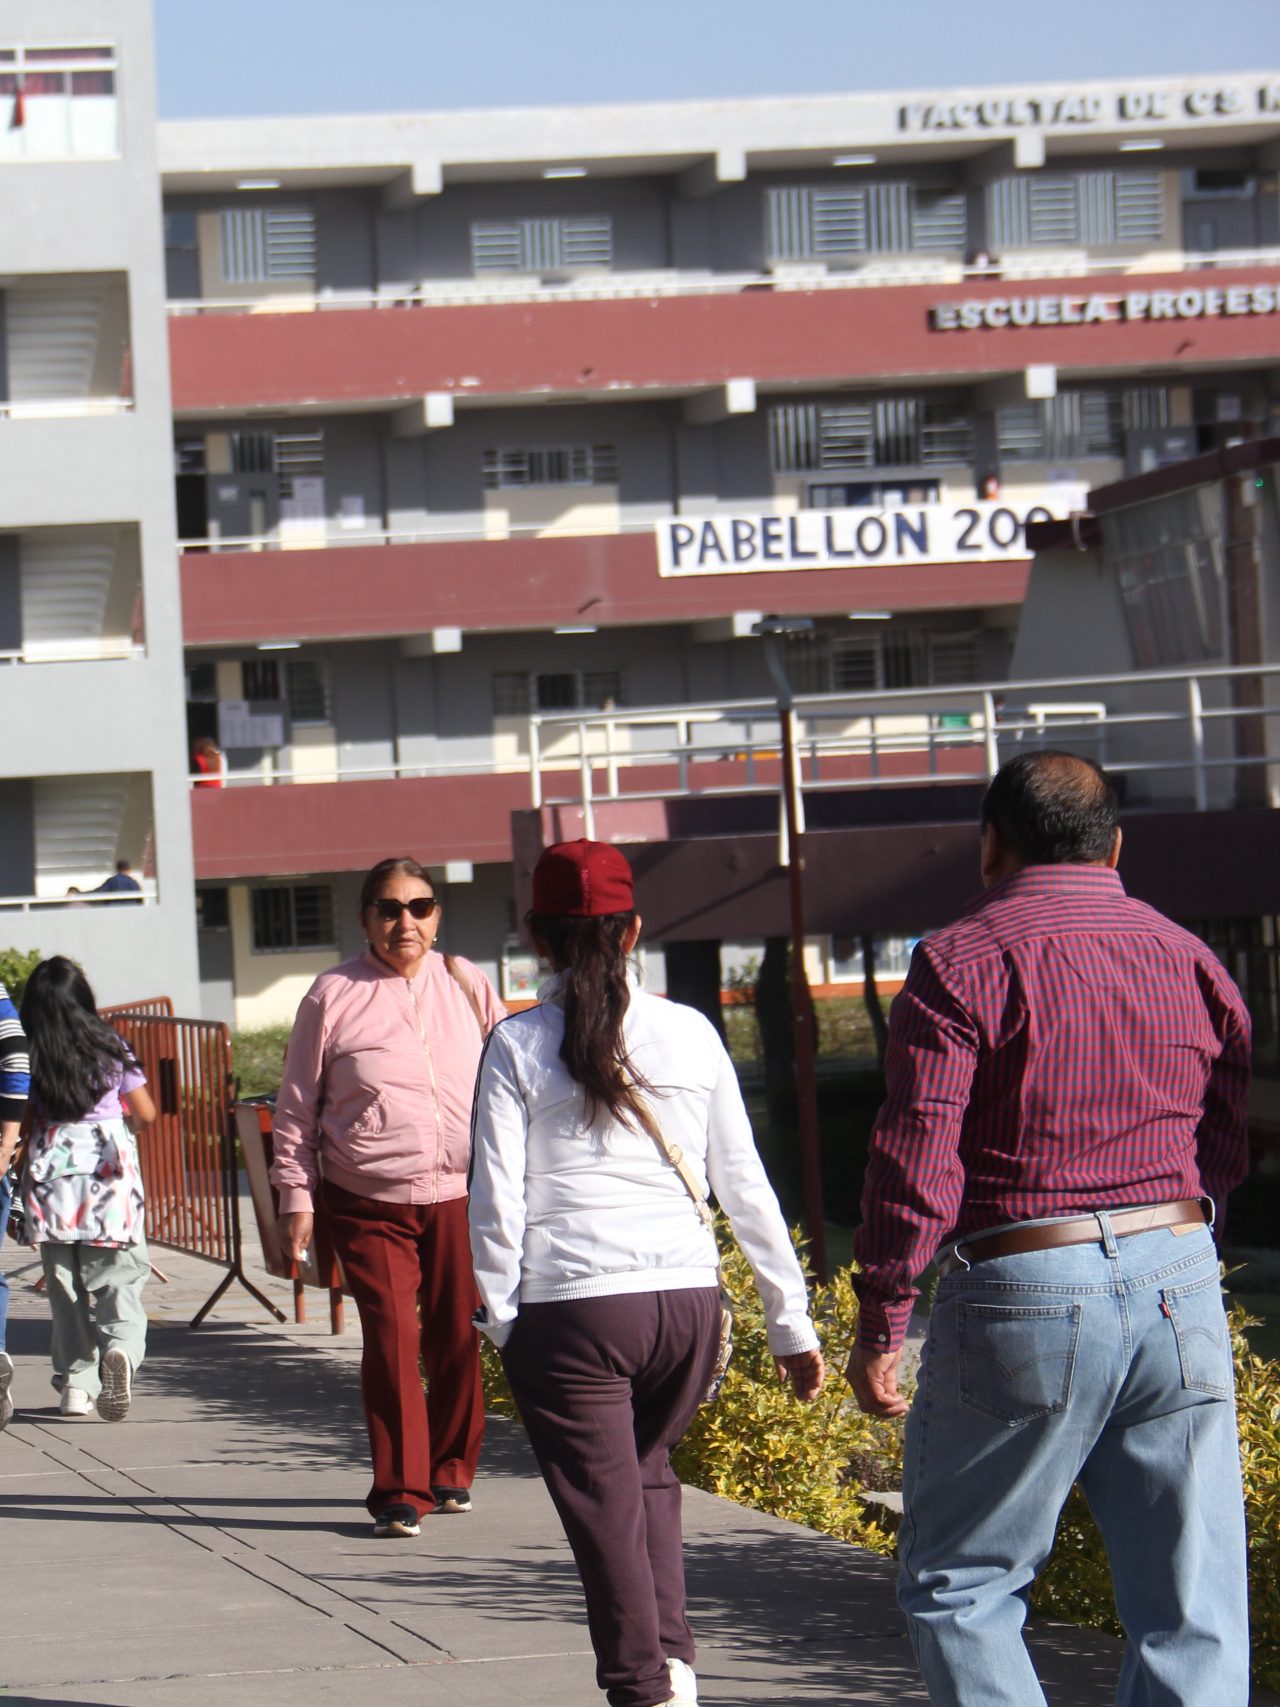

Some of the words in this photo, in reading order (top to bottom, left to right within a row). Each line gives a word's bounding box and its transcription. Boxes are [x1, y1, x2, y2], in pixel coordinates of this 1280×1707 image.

[898, 93, 1103, 131] FACULTAD
[1118, 88, 1168, 120] DE
[930, 293, 1111, 331] ESCUELA
